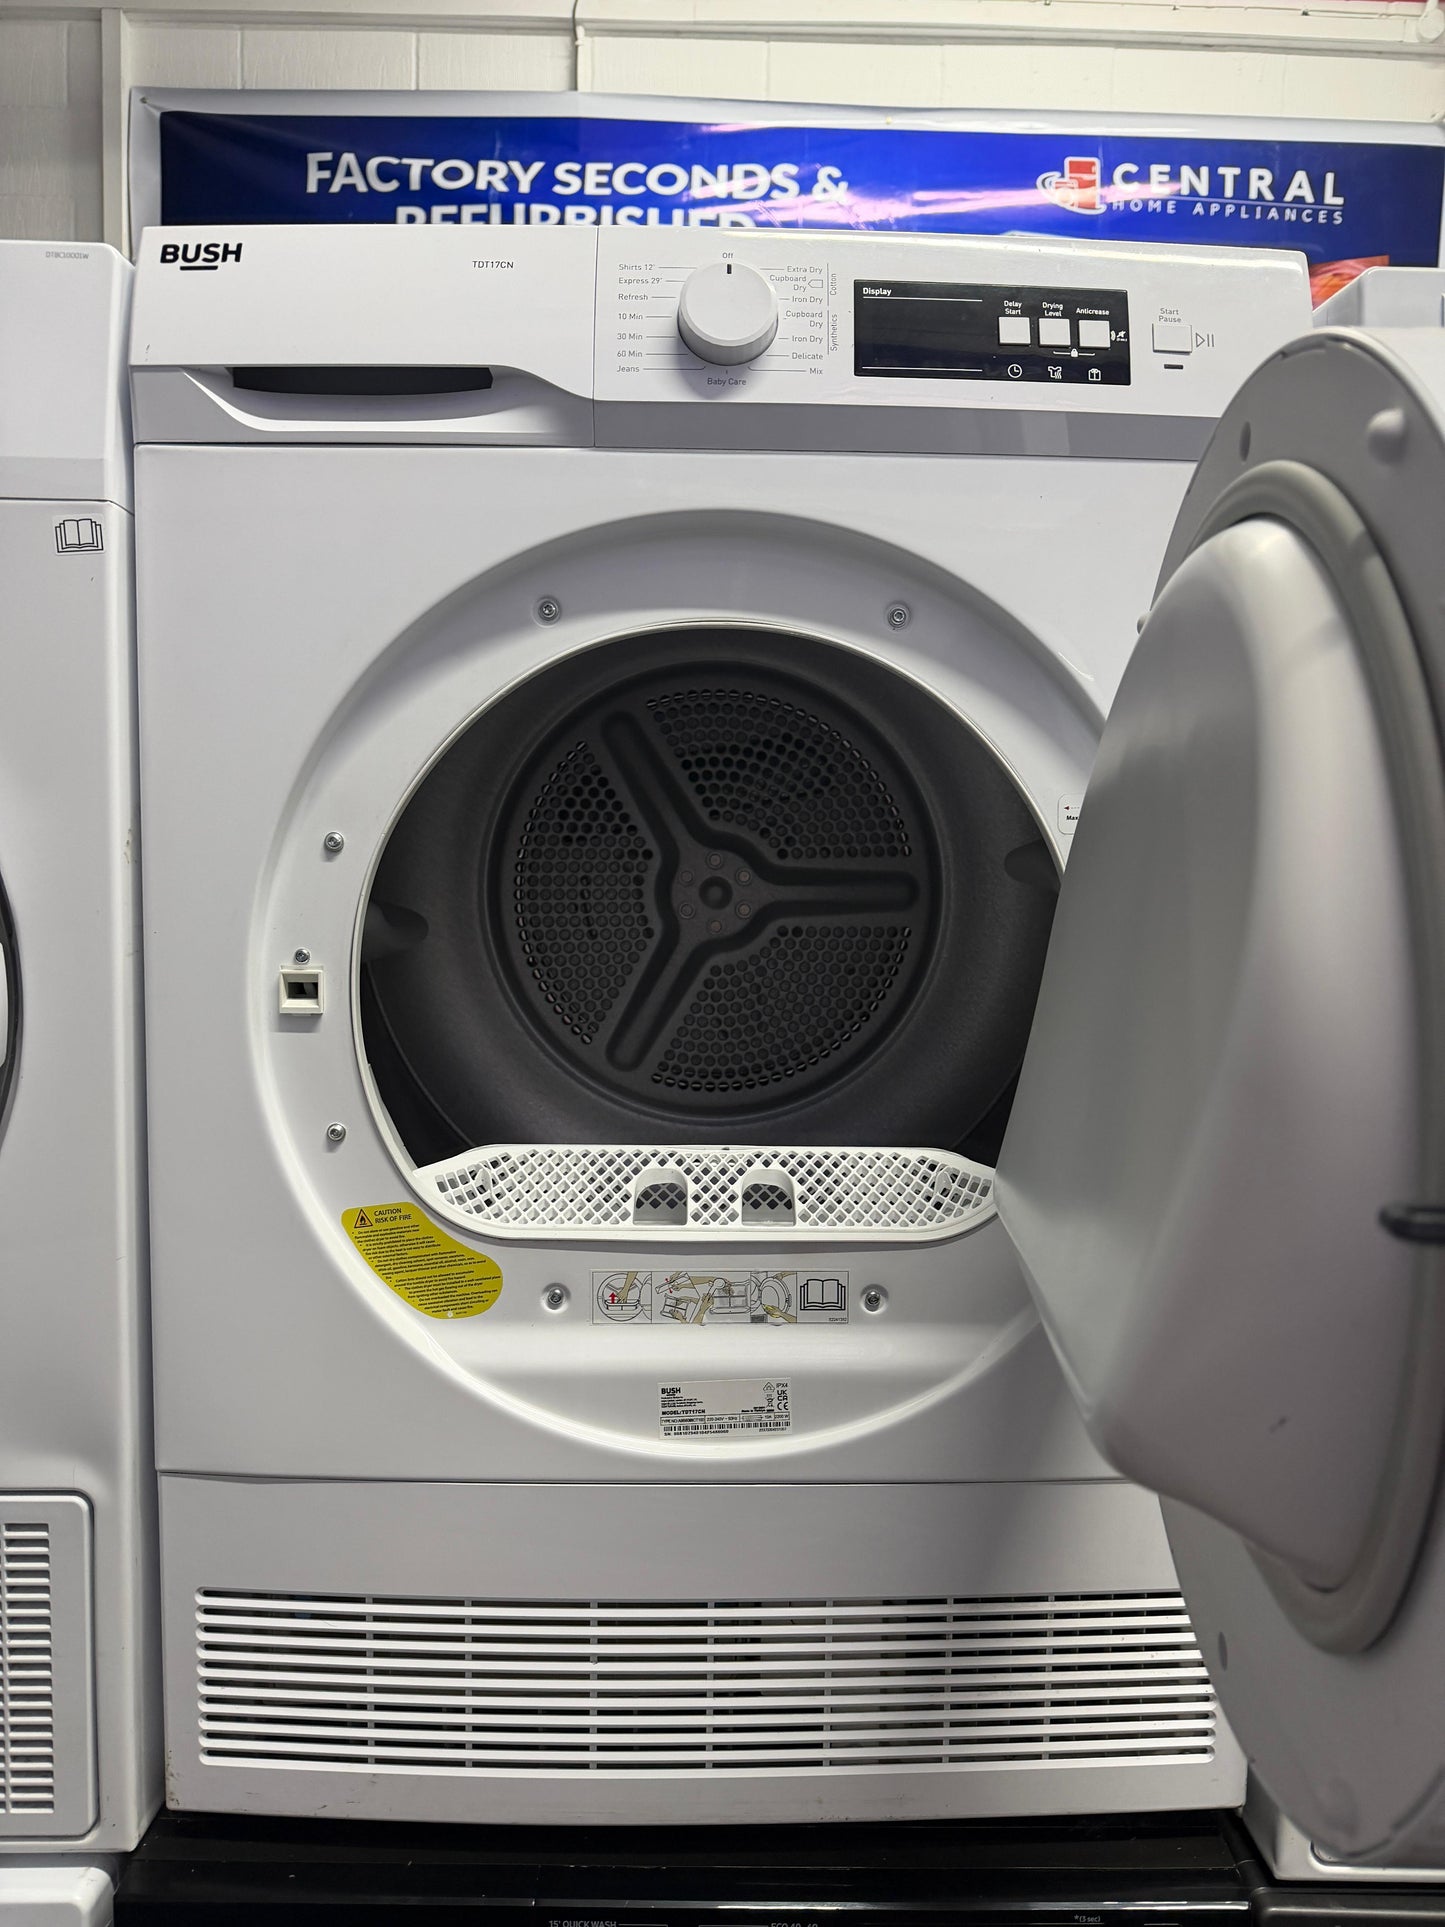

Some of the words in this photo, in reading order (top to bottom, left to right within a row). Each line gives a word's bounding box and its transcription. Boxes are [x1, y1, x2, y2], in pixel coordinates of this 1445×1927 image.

[306, 152, 545, 194] FACTORY
[552, 162, 800, 199] SECONDS
[812, 166, 849, 202] &
[1113, 162, 1345, 205] CENTRAL
[1112, 199, 1177, 214] HOME
[1192, 202, 1344, 225] APPLIANCES
[160, 243, 243, 263] BUSH
[471, 260, 514, 269] TDT17CN
[809, 266, 823, 274] Dry
[618, 277, 649, 286] Express
[769, 274, 807, 283] Cupboard
[793, 284, 807, 292] Dry
[829, 273, 837, 296] Cotton
[862, 287, 892, 296] Display
[618, 293, 649, 301] Refresh
[809, 296, 823, 304] Dry
[1003, 300, 1022, 309] Delay
[1042, 302, 1064, 311] Drying
[785, 310, 823, 319] Cupboard
[1076, 308, 1110, 316] Anticrease
[1160, 308, 1179, 316] Start
[809, 320, 824, 328] Dry
[830, 314, 839, 351] Synthetics
[809, 336, 823, 344] Dry
[792, 352, 824, 360] Delicate
[707, 378, 726, 387] Baby
[728, 378, 747, 386] Care
[374, 1207, 402, 1216] CAUTION
[375, 1216, 389, 1224] RISK
[399, 1213, 412, 1221] FIRE
[661, 1387, 681, 1395] BUSH
